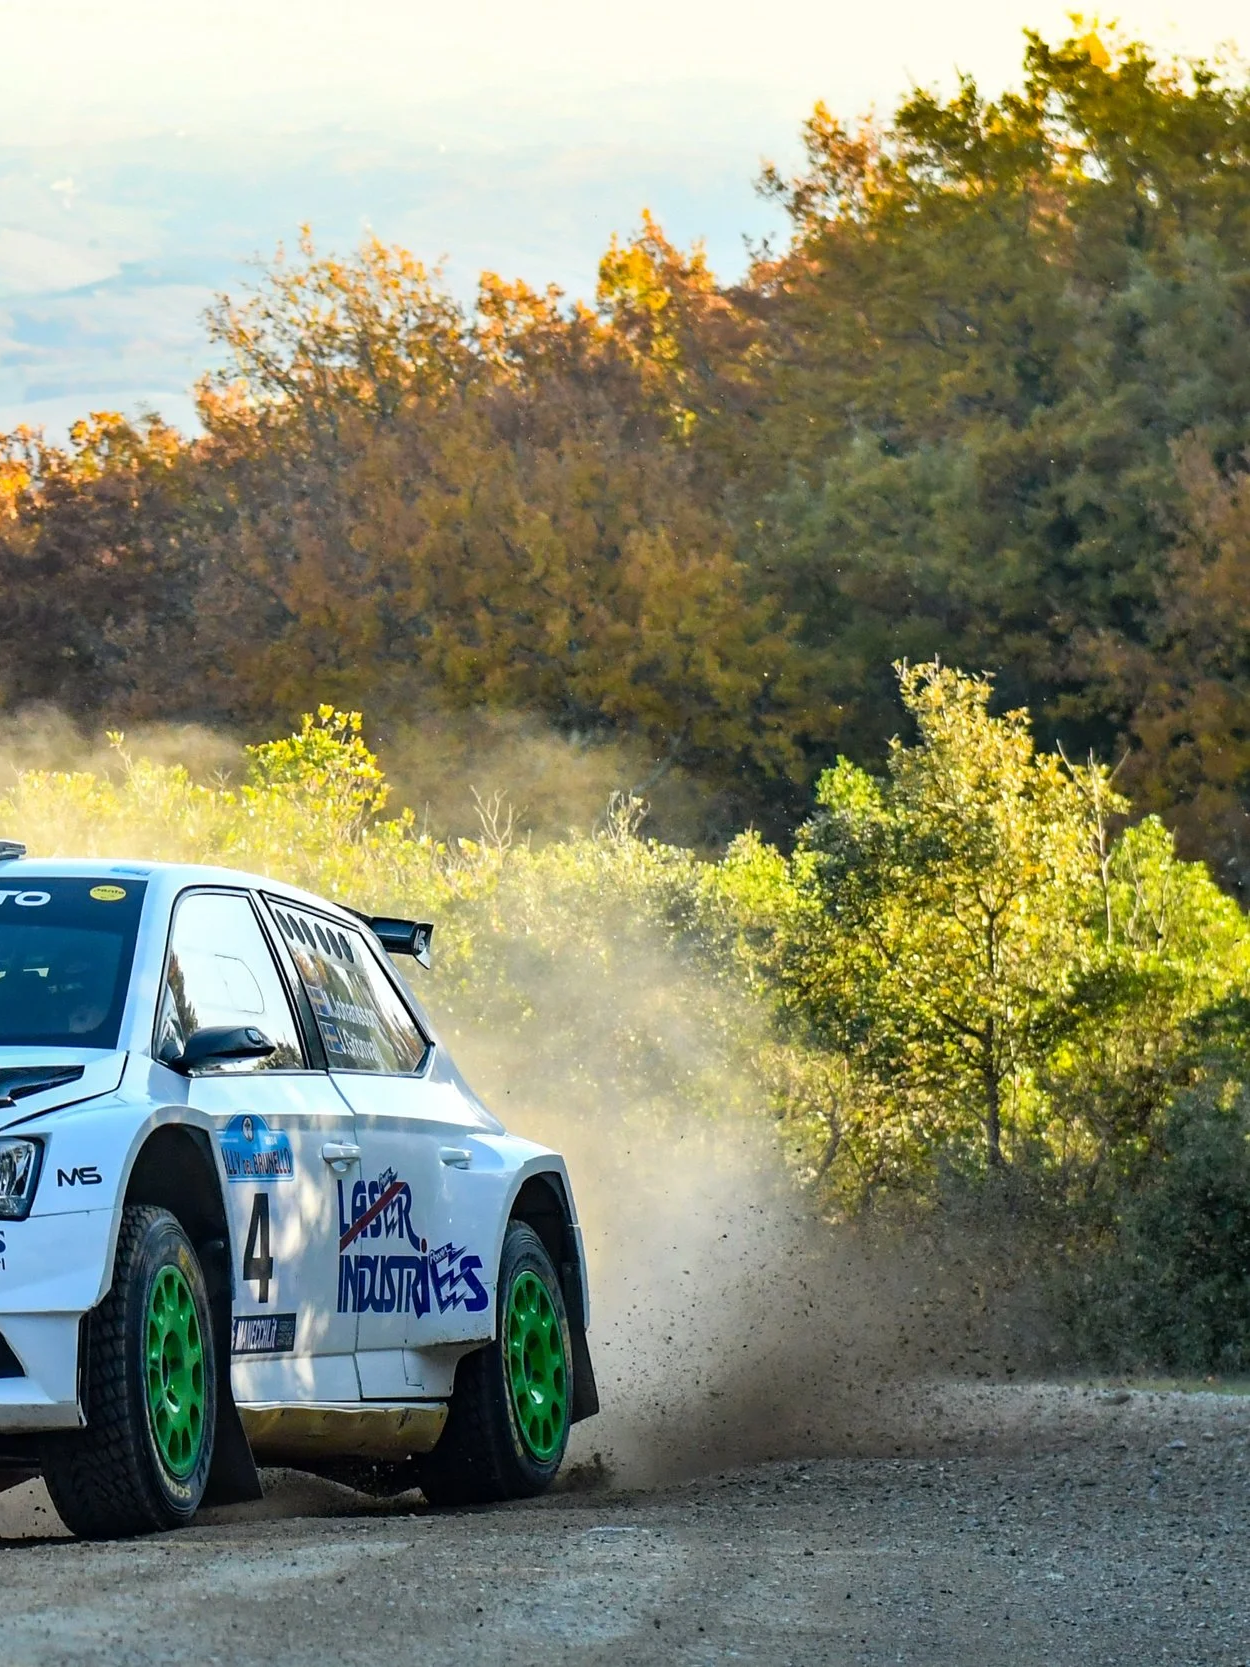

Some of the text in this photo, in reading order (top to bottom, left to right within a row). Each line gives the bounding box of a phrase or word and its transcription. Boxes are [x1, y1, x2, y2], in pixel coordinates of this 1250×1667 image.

[57, 1166, 103, 1187] MS
[243, 1192, 274, 1304] 4
[337, 1242, 490, 1319] INDUSTRIES
